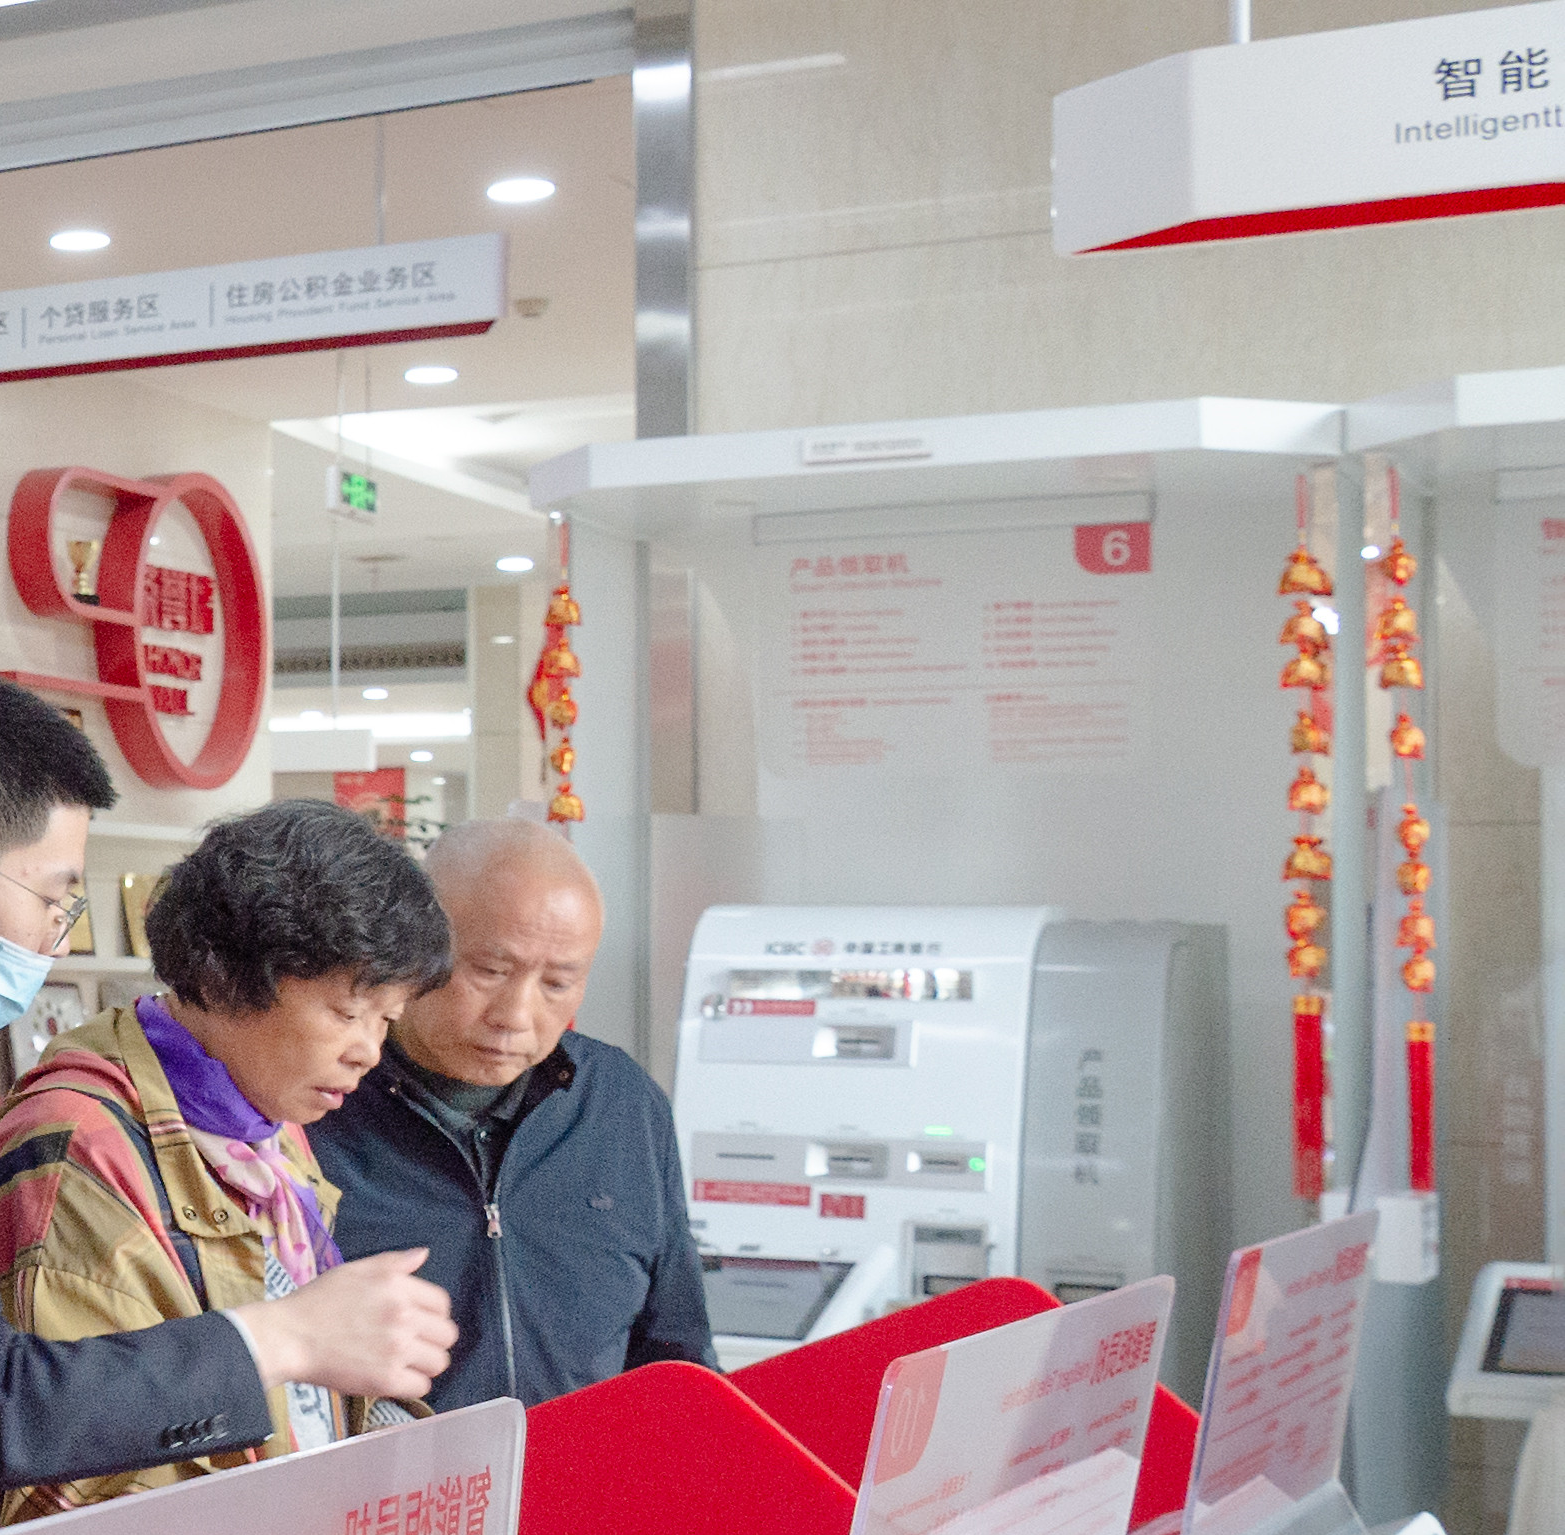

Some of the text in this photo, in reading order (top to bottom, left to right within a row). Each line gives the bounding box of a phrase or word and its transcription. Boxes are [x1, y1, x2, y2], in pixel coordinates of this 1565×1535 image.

[1434, 48, 1549, 100] 智能
[226, 260, 435, 308] 住房公积金业务区
[38, 292, 159, 330] 个贷服务区
[1101, 530, 1131, 566] 6
